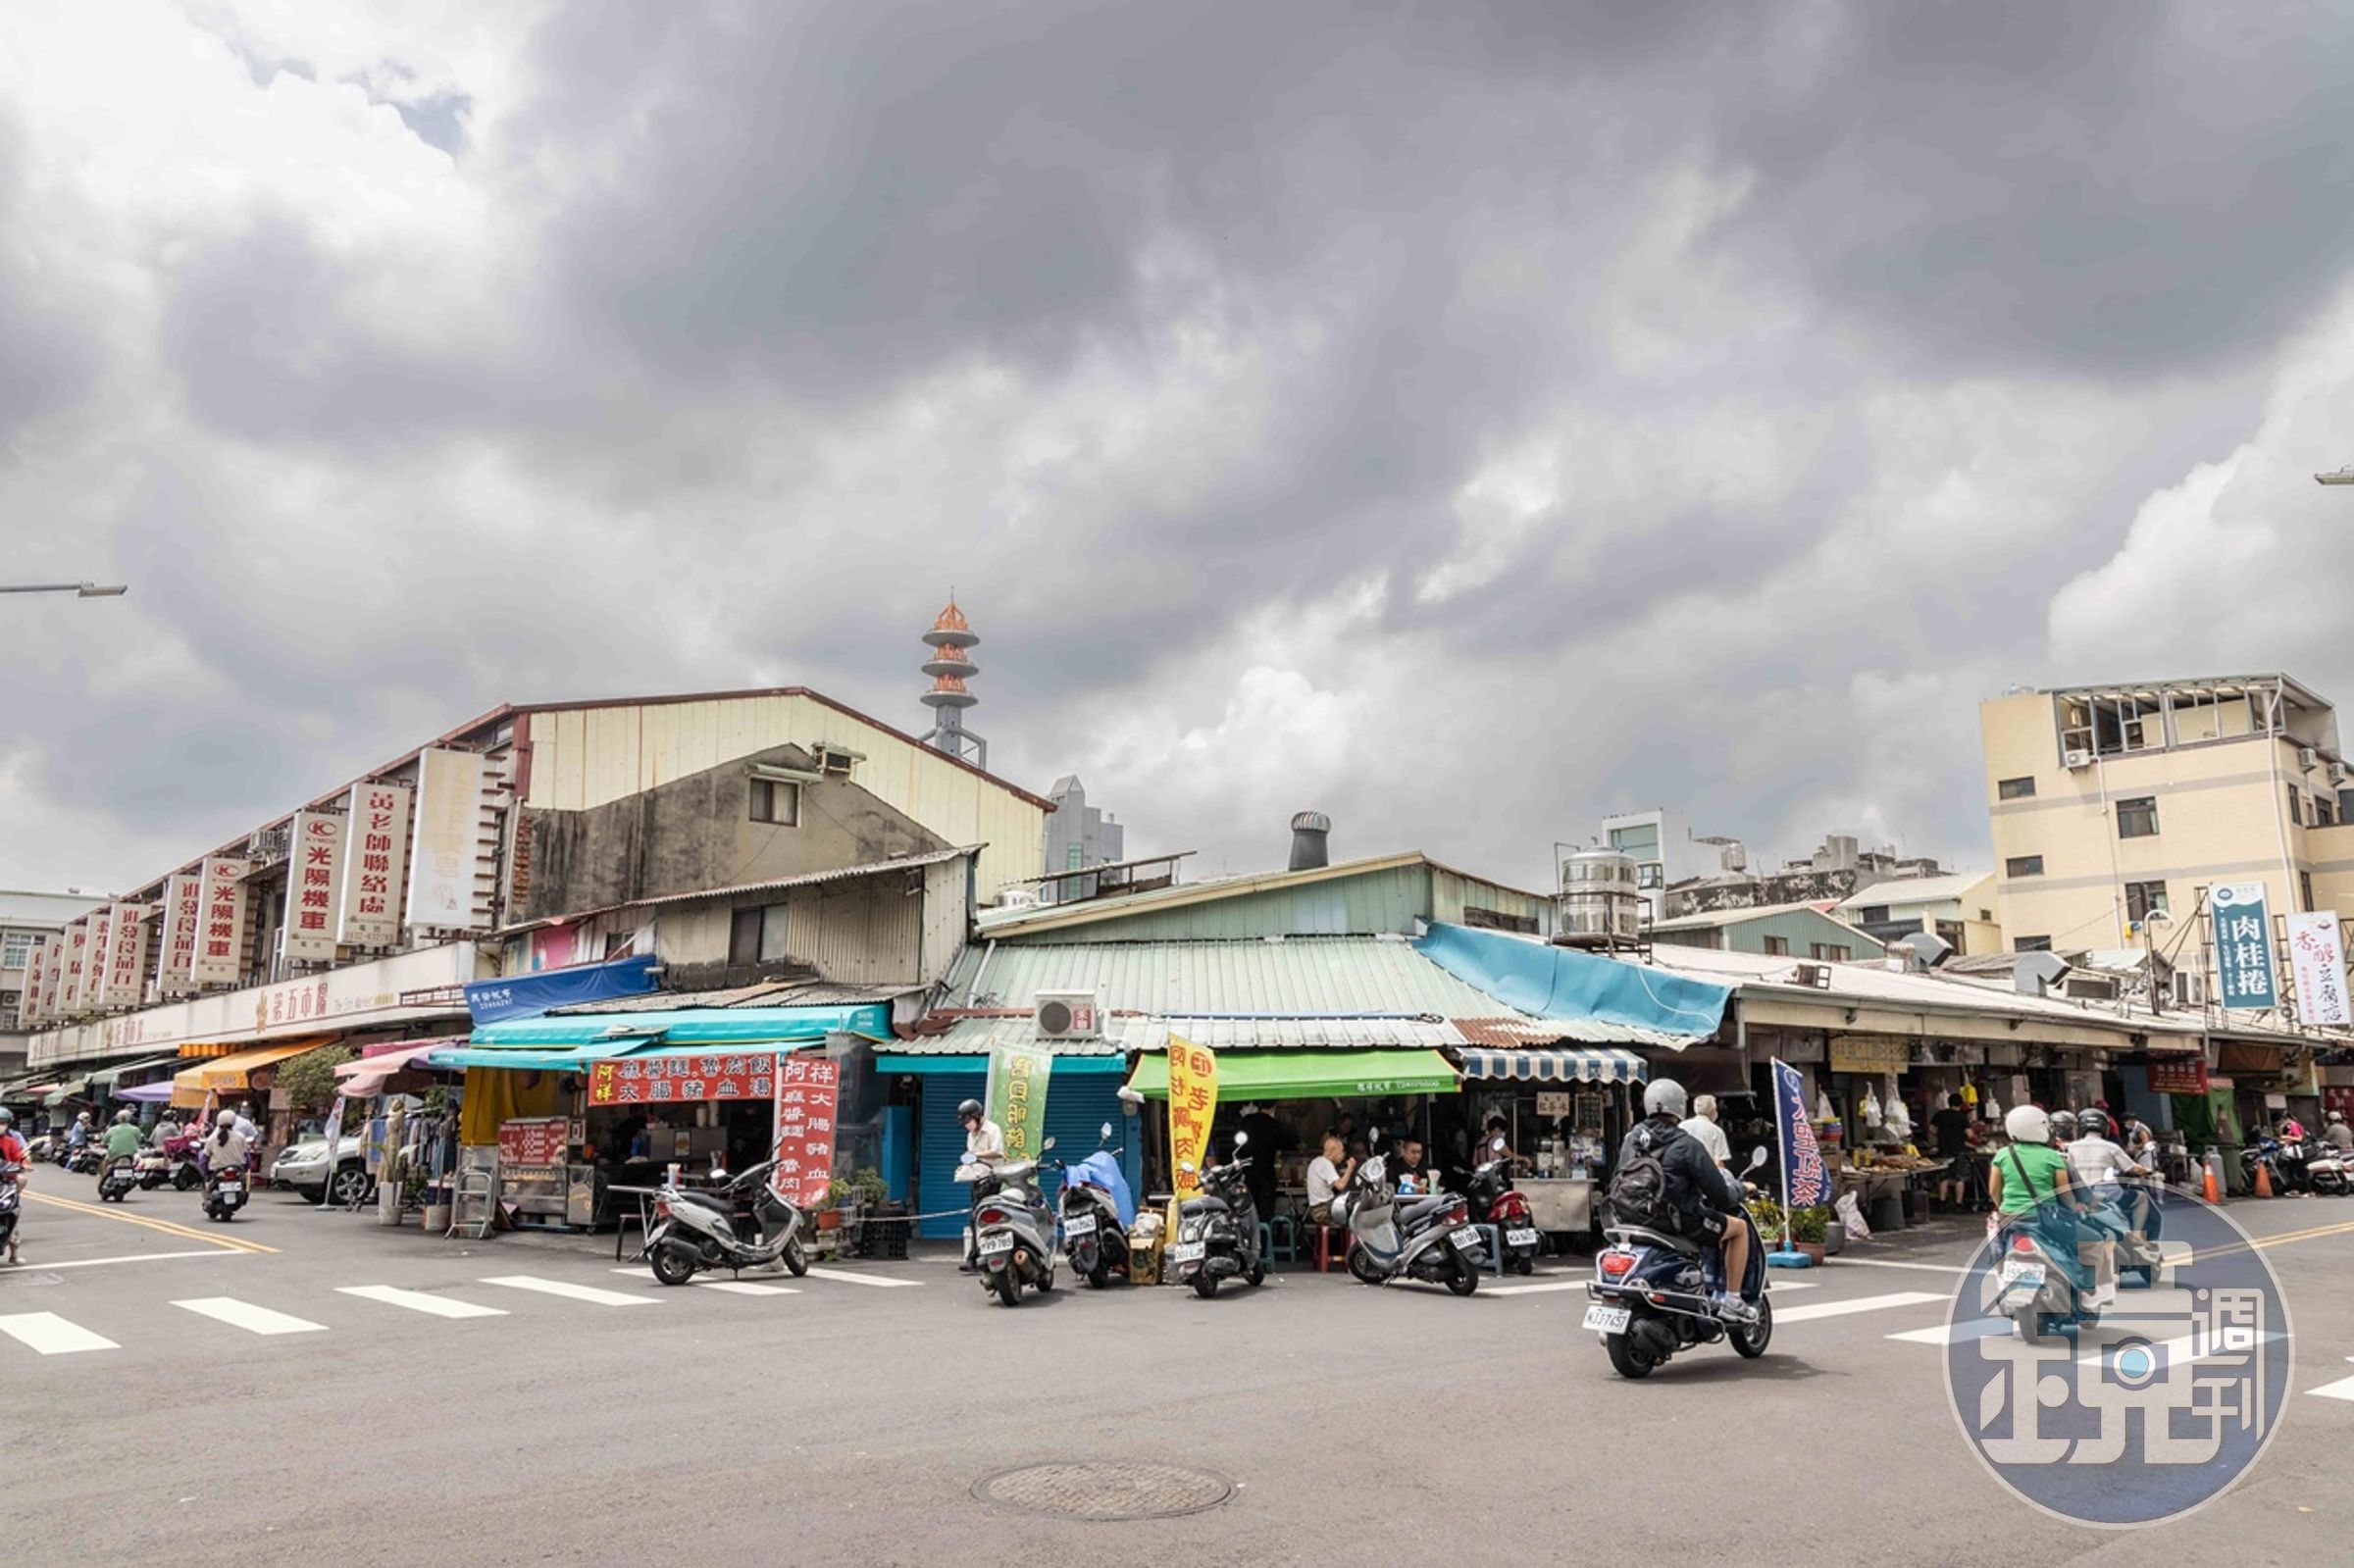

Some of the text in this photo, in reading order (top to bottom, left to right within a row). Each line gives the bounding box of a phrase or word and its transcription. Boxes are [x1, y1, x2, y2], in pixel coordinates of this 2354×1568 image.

[207, 885, 235, 957] 光陽機車
[299, 846, 333, 930] 光陽機車
[2231, 915, 2268, 995] 肉桂捲
[595, 1063, 615, 1102] 阿祥
[785, 1060, 834, 1084] 阿祥
